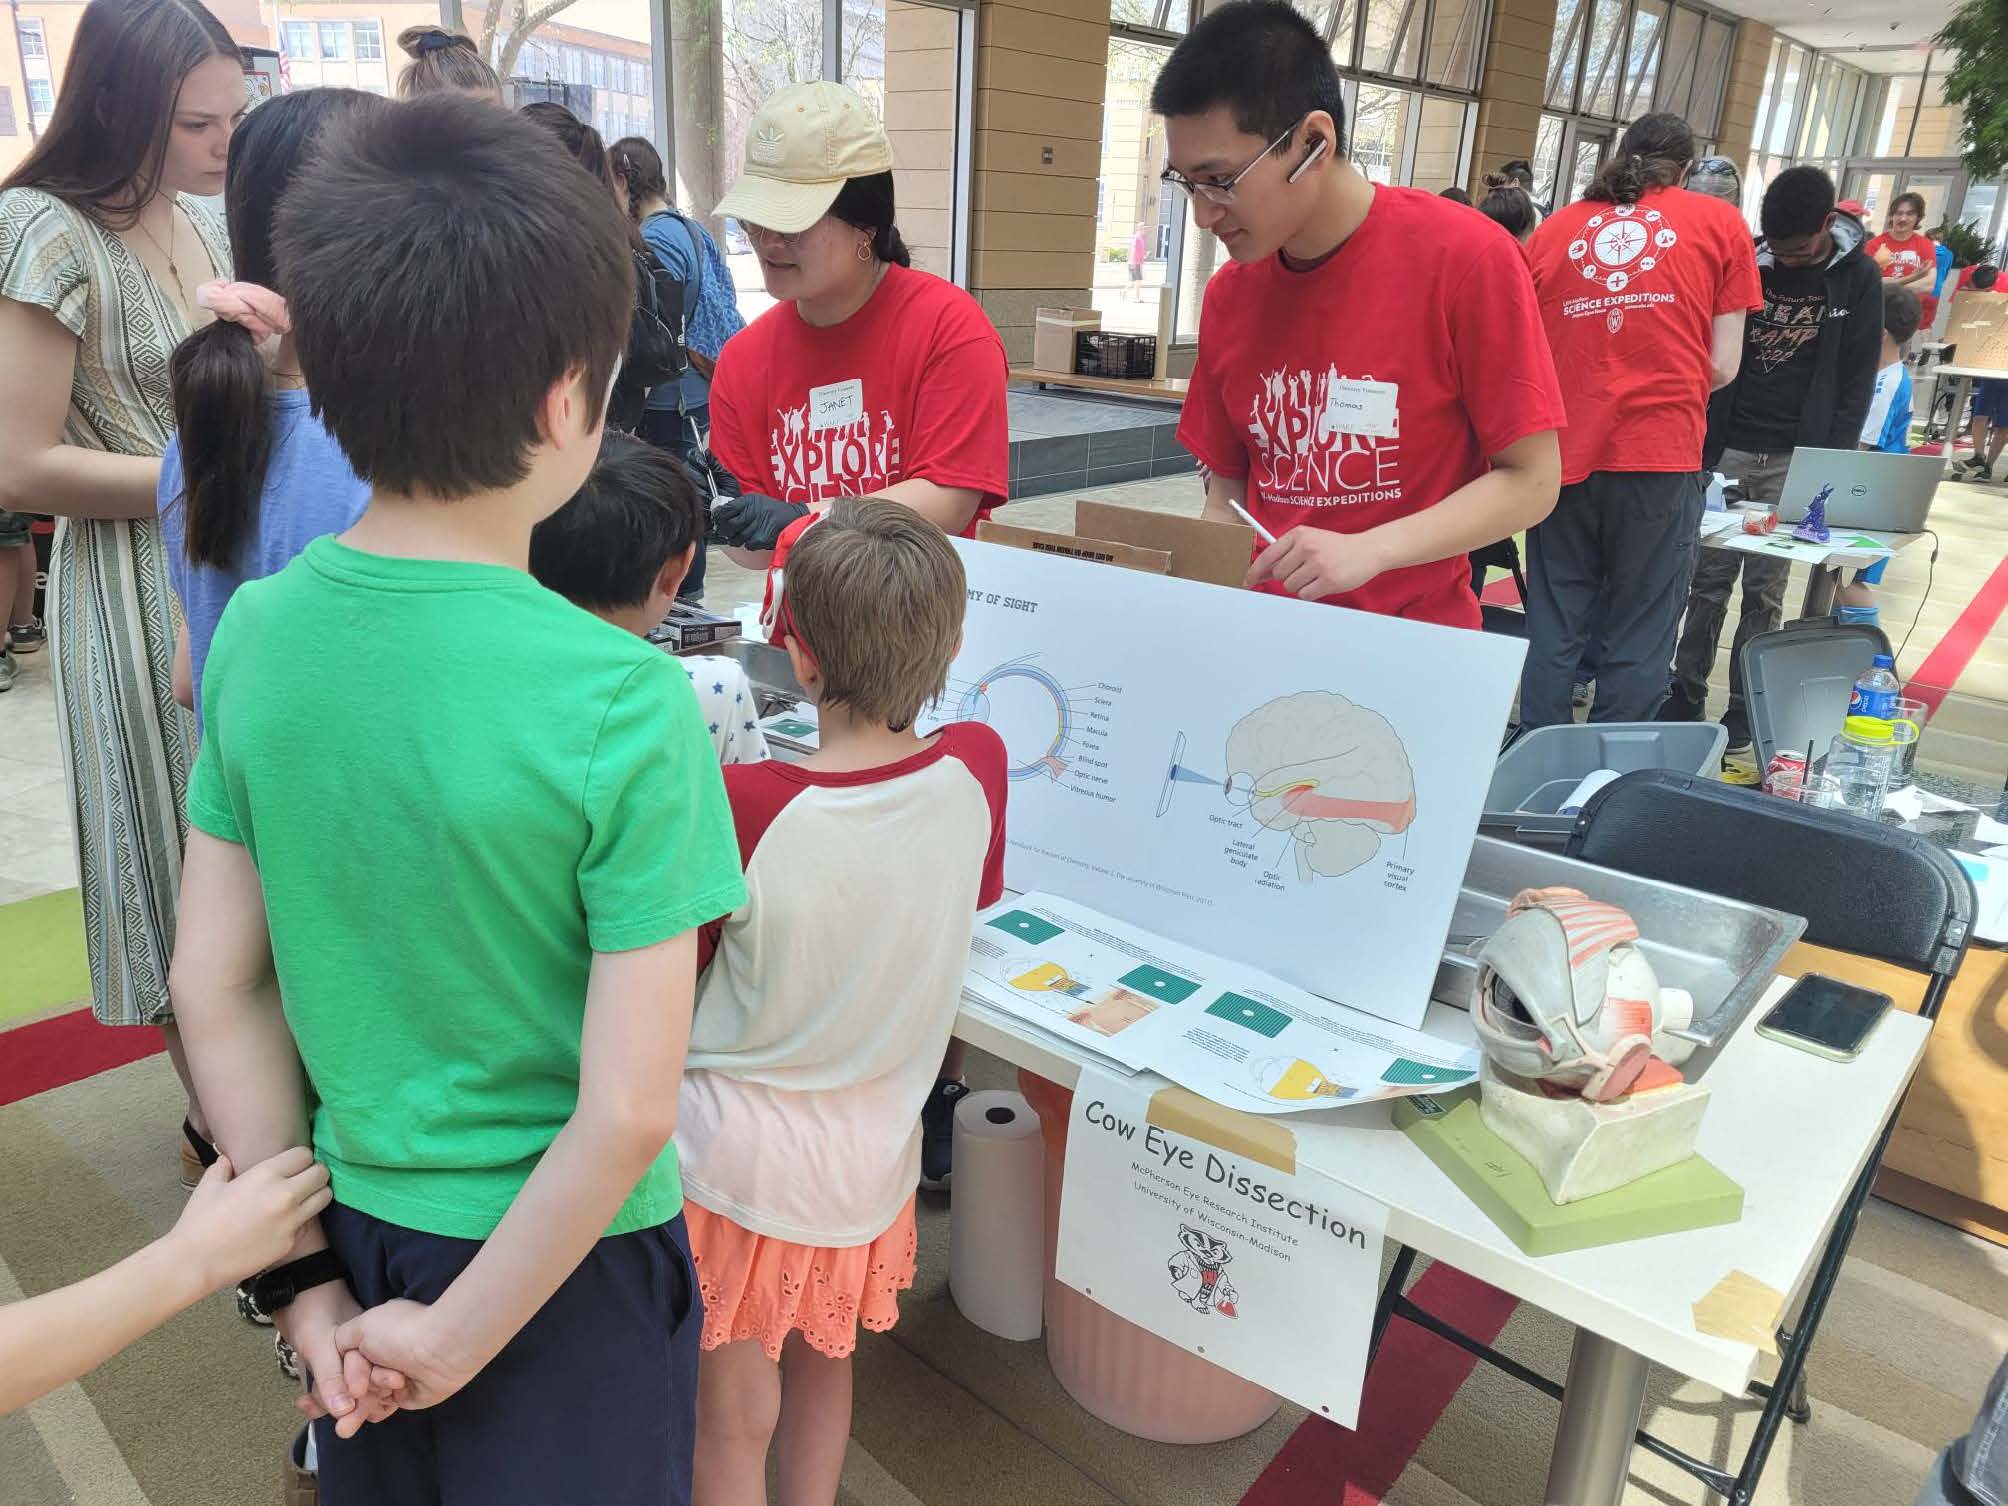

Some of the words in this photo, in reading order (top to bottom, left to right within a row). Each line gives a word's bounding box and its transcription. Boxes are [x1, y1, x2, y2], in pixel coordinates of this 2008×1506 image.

[1563, 298, 1602, 316] SCIENCE
[1604, 292, 1676, 307] EXPEDITIONS
[819, 395, 853, 414] JANET
[1329, 396, 1363, 411] Thomas
[1258, 446, 1400, 493] SCIENCE
[1290, 494, 1315, 507] SCIENCE
[1316, 487, 1402, 507] EXPEDITIONS
[986, 593, 1001, 606] OF
[1003, 596, 1038, 613] SIGHT
[1098, 682, 1122, 694] Choroid
[1094, 696, 1112, 707] Sclera
[1090, 711, 1109, 722] Retina
[1086, 726, 1108, 737] Macula
[1082, 740, 1100, 751] Fovea
[1078, 755, 1094, 766] Blind
[1094, 759, 1108, 769] spot
[1074, 769, 1091, 781] Optic
[1091, 774, 1109, 784] nerve
[1070, 784, 1095, 798] Vitreous
[1095, 790, 1116, 803] humor
[1209, 814, 1227, 825] Optic
[1227, 819, 1243, 829] tract
[1232, 839, 1255, 850] Lateral
[1224, 847, 1258, 860] geniculate
[1230, 857, 1246, 867] body
[1386, 861, 1415, 876] Primary
[1263, 870, 1280, 881] Optic
[1387, 872, 1408, 882] visual
[1254, 879, 1285, 892] radiation
[1383, 880, 1406, 891] cortex
[1085, 1100, 1136, 1141] Cow
[1145, 1126, 1194, 1168] Eye
[1205, 1152, 1366, 1250] Dissection
[1131, 1161, 1181, 1192] McPherson
[1183, 1186, 1201, 1203] Eye
[1203, 1195, 1248, 1225] Research
[1251, 1216, 1299, 1247] Institute
[1134, 1181, 1181, 1213] University
[1183, 1204, 1197, 1216] of
[1198, 1210, 1292, 1263] Wisconsin-Madison
